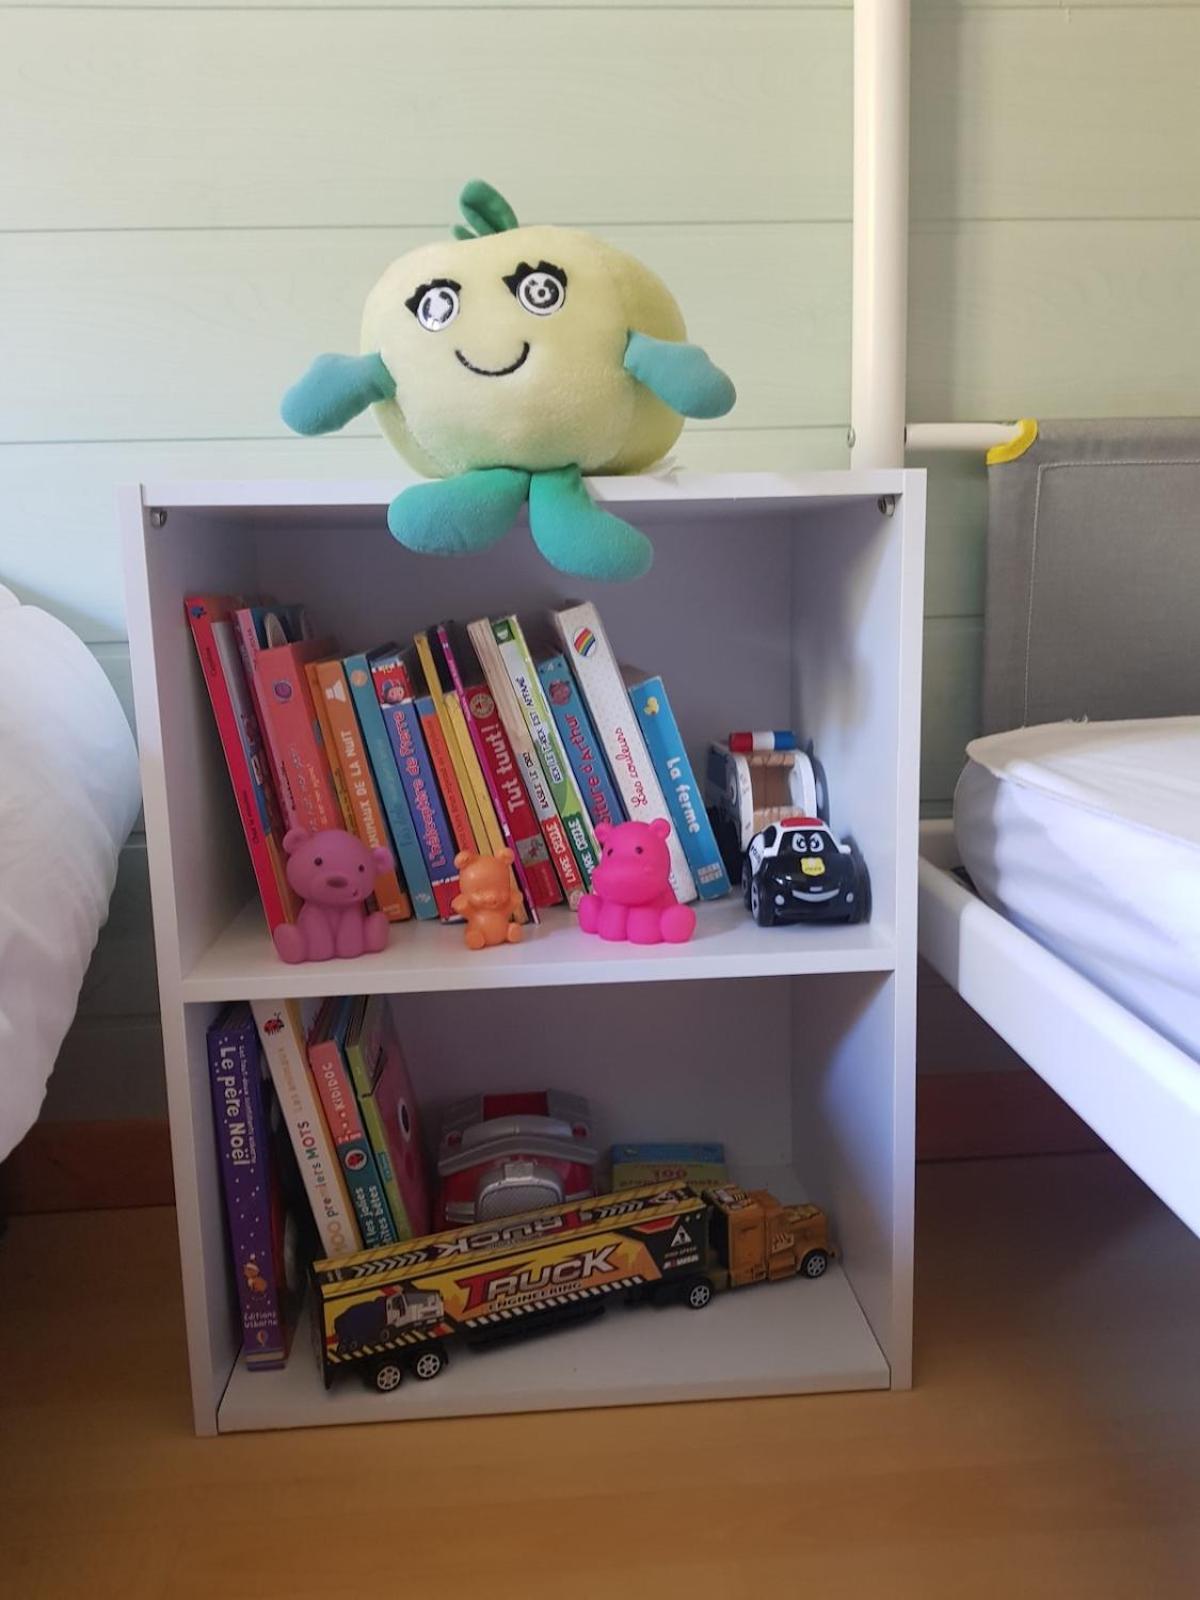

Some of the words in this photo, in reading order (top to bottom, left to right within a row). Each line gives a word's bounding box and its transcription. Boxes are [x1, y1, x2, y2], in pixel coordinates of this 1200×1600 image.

[529, 711, 541, 727] EST
[350, 762, 364, 777] LA
[404, 757, 420, 776] de
[615, 727, 638, 778] couleurs
[354, 780, 368, 798] DE
[528, 770, 539, 781] LE
[501, 777, 524, 814] Tut
[588, 776, 613, 824] oiture
[667, 757, 682, 780] La
[676, 783, 700, 834] ferme
[559, 857, 576, 884] LIVRE
[219, 1046, 236, 1070] Le
[216, 1076, 243, 1117] père
[228, 1123, 251, 1165] Noël
[297, 1120, 319, 1160] MOTS
[368, 1185, 384, 1217] bêtes
[433, 1208, 582, 1258] TRUCK
[455, 1242, 622, 1313] TRUCK
[488, 1279, 582, 1312] ENGINEERING
